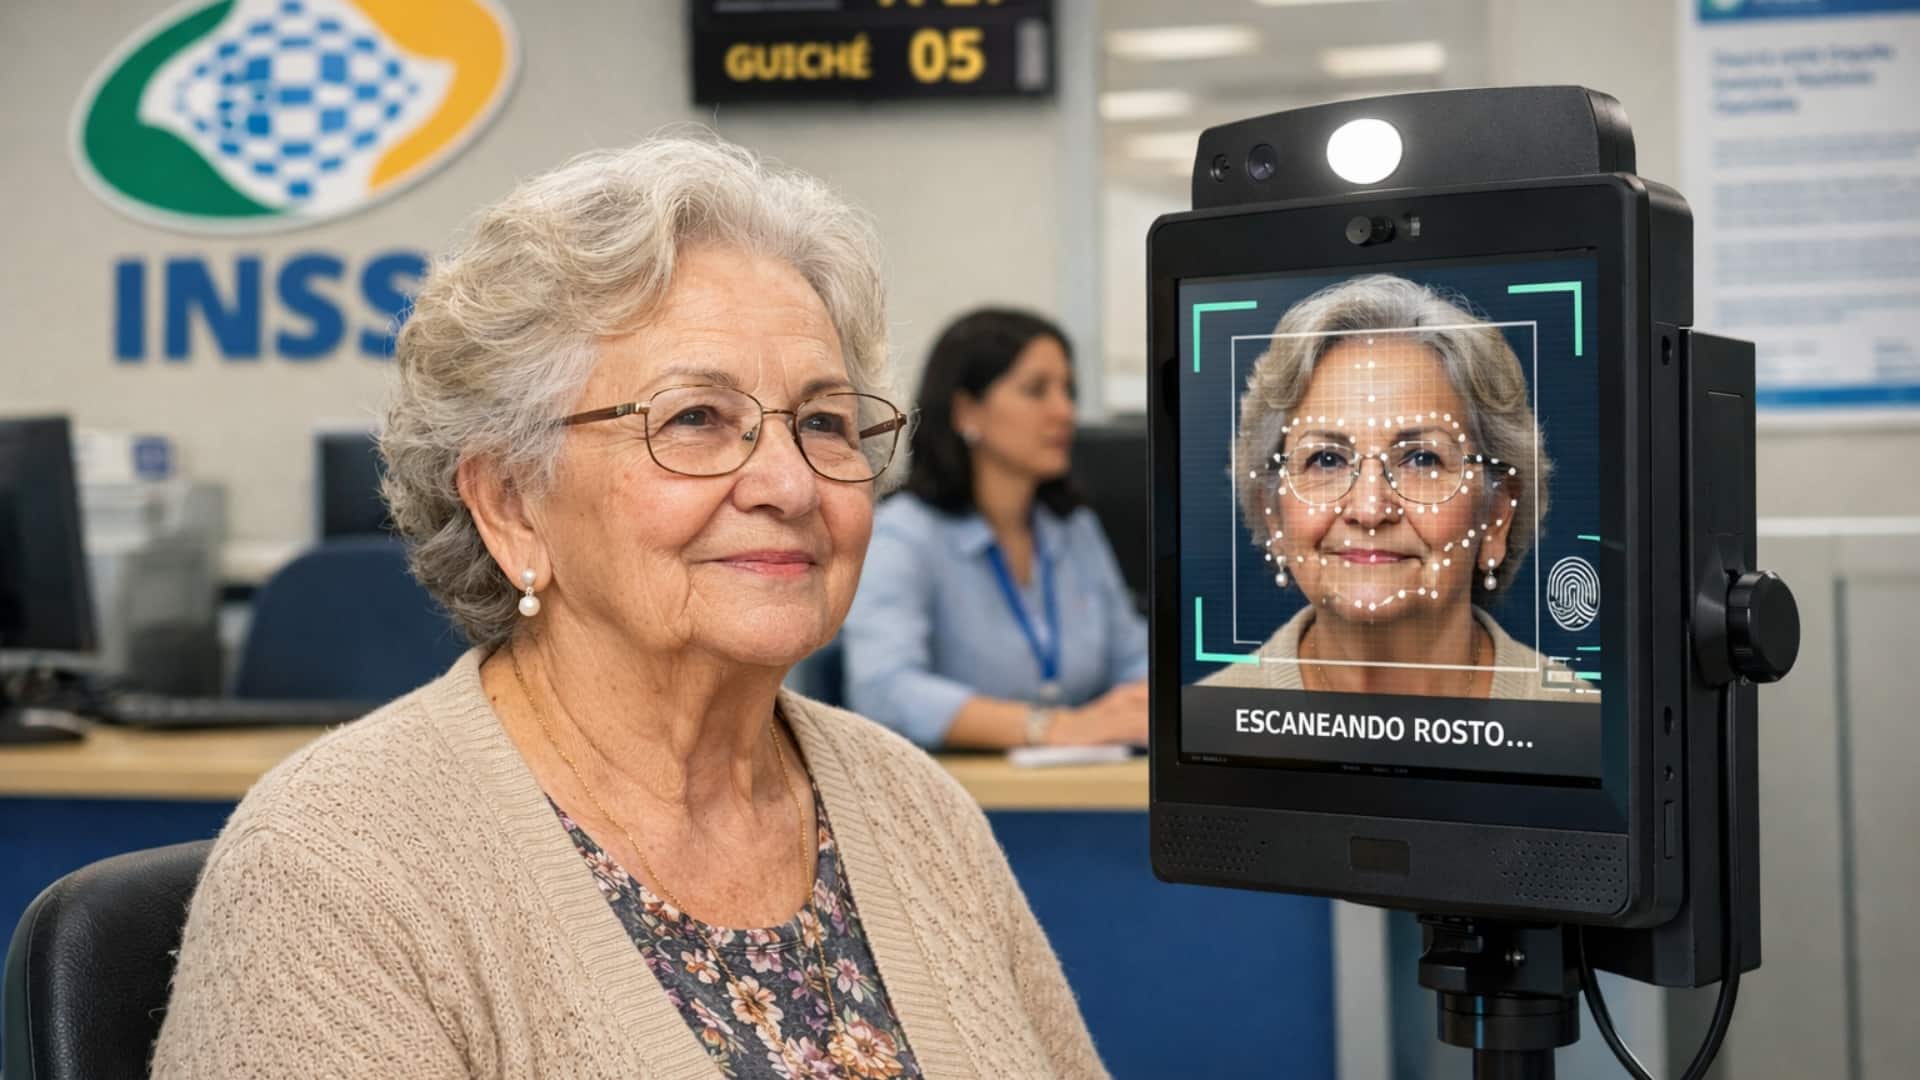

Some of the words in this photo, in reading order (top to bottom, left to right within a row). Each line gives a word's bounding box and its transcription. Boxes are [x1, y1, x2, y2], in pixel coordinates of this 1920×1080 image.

[725, 33, 871, 80] GUICHÉ
[909, 28, 985, 83] 05
[114, 251, 430, 362] INSS
[1235, 709, 1405, 741] ESCANEANDO
[1413, 718, 1534, 749] ROSTO...
